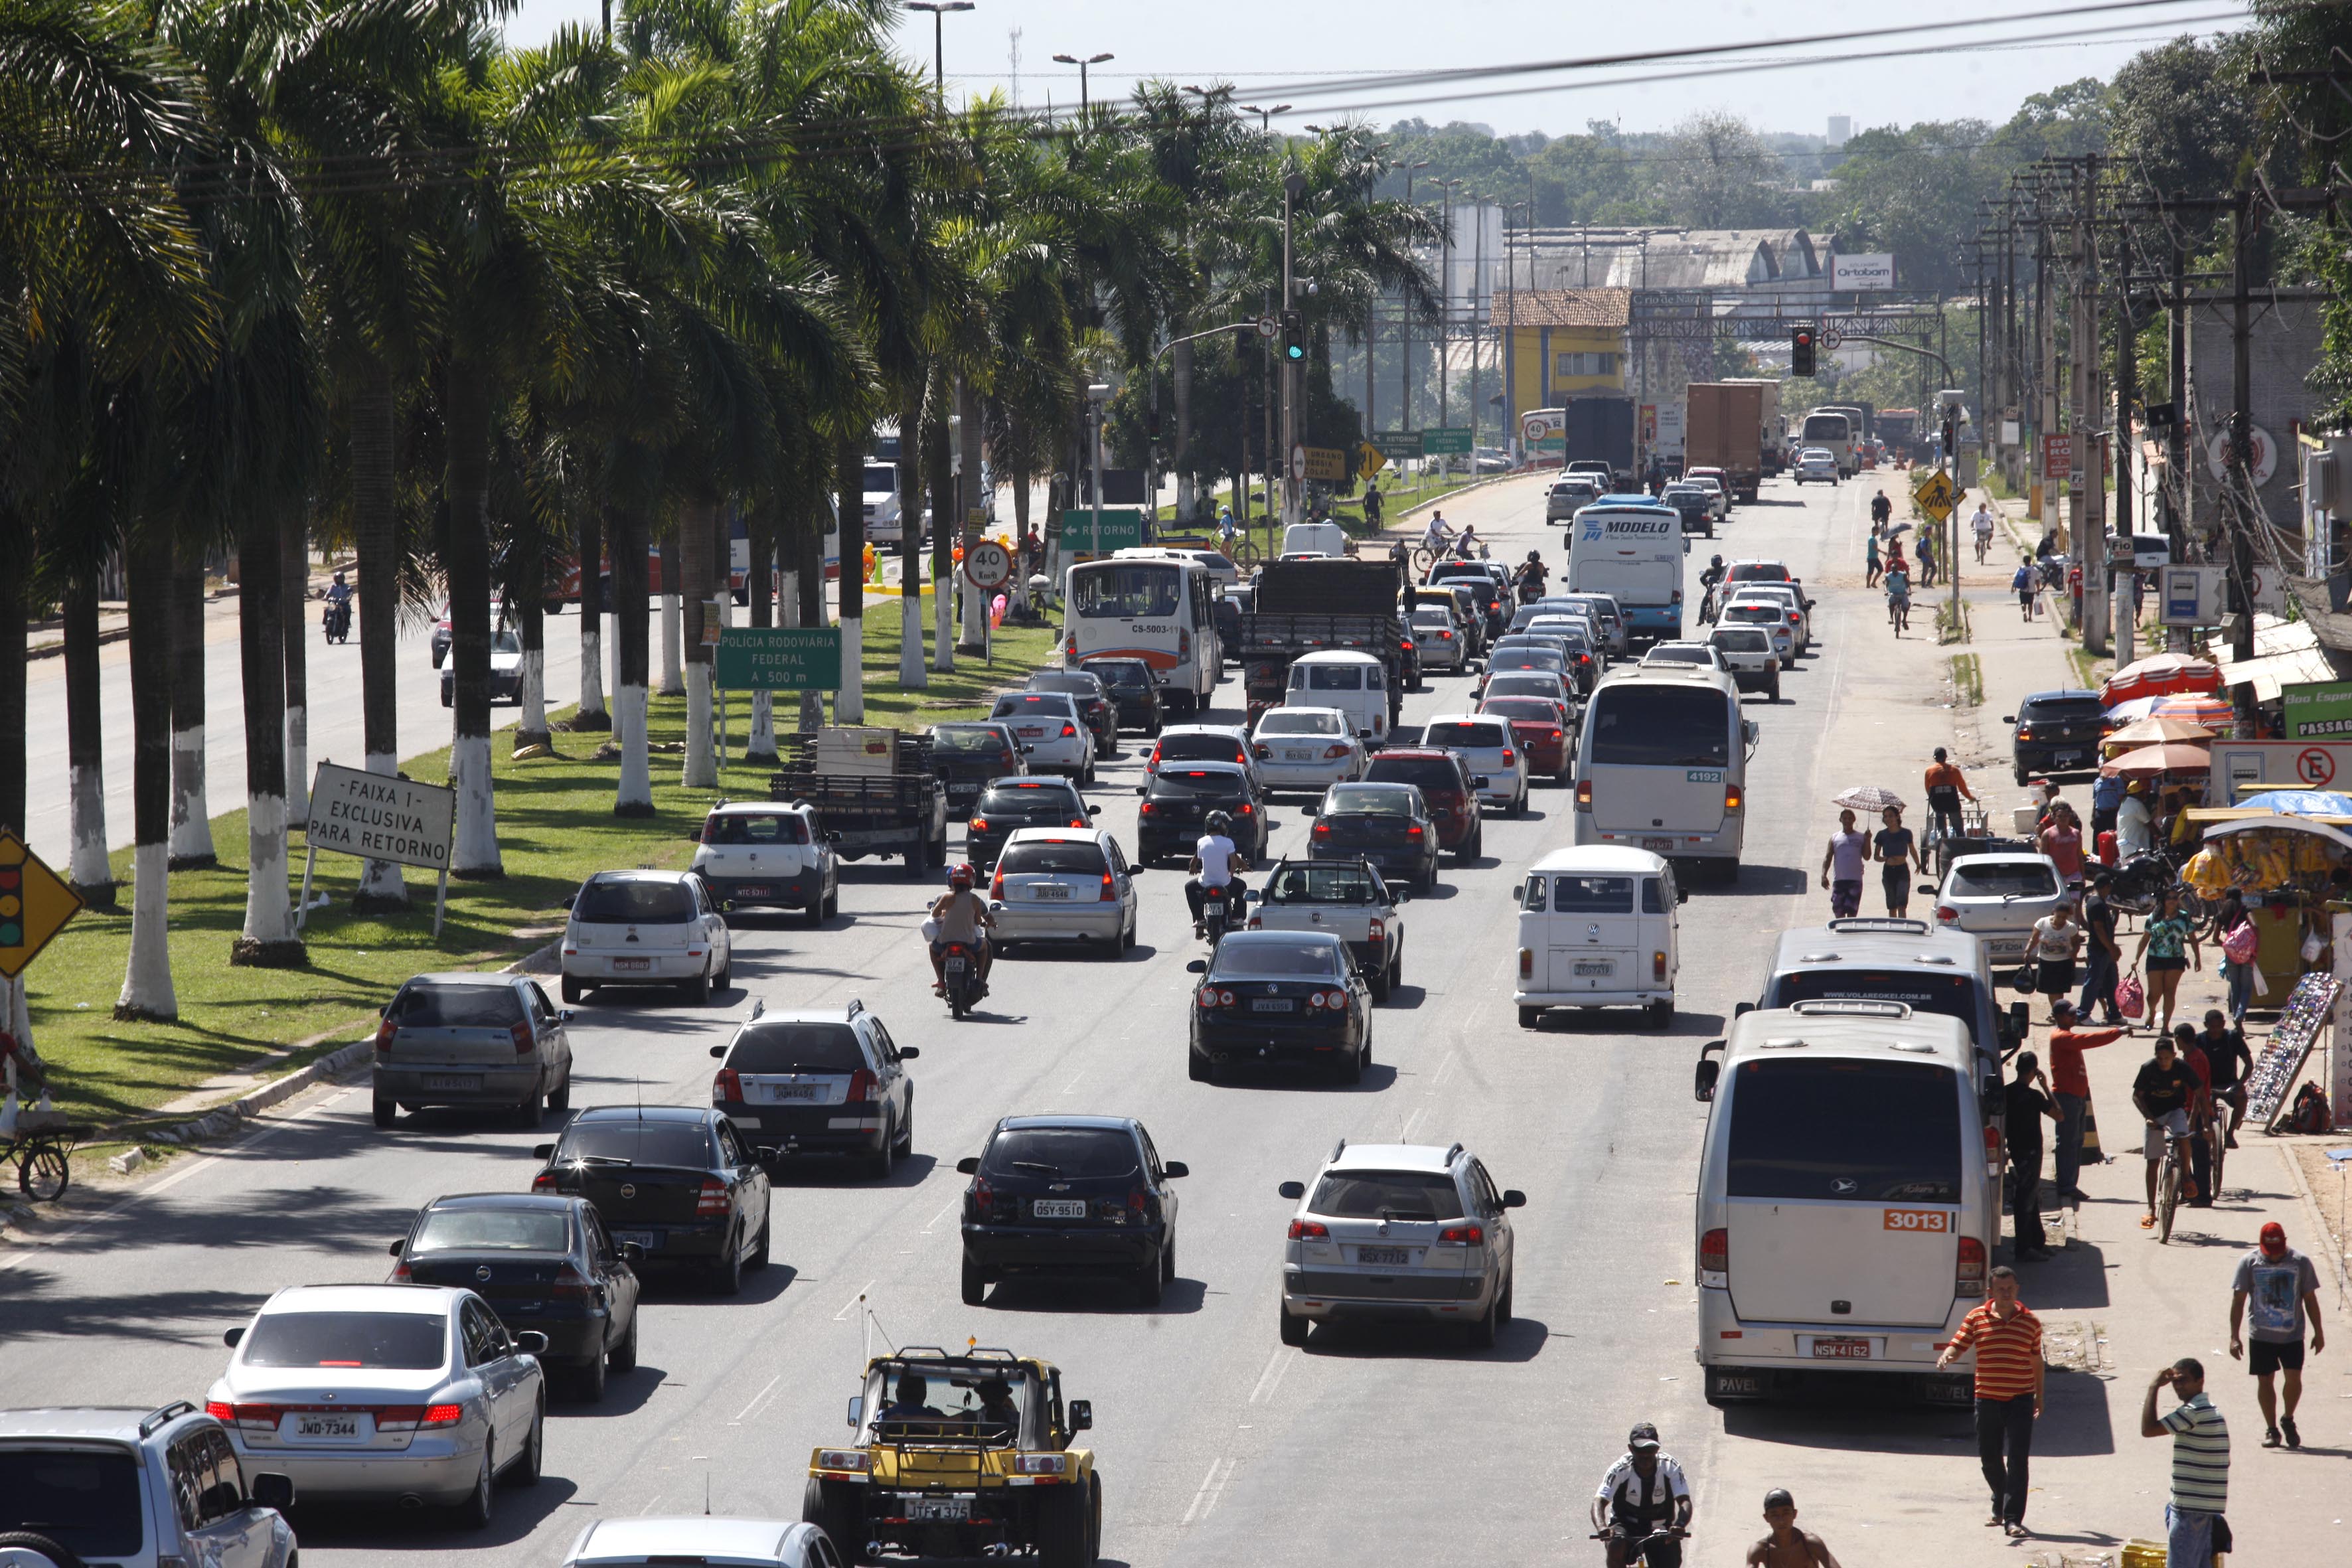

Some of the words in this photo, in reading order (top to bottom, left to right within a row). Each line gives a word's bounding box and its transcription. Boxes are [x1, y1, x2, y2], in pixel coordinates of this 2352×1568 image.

[1838, 268, 1889, 276] Ortobom
[1082, 525, 1135, 536] RETORNO
[1605, 521, 1670, 533] MODELO
[2112, 541, 2131, 551] Fio
[975, 550, 1000, 565] 40
[1132, 625, 1179, 634] CS-5003-11
[722, 634, 764, 648] POLÍCIA
[769, 634, 835, 648] RODOVIÁRIA
[751, 654, 805, 665] FEDERAL
[751, 672, 759, 682] A
[768, 672, 790, 682] 500
[796, 673, 807, 682] m
[2299, 719, 2352, 736] PASSAG
[1689, 772, 1719, 781] 4192
[331, 801, 424, 834] EXCLUSIVA
[310, 820, 351, 844] PARA
[361, 831, 445, 860] RETORNO
[1888, 1212, 1944, 1229] 3013
[1719, 1378, 1759, 1392] PAVEL
